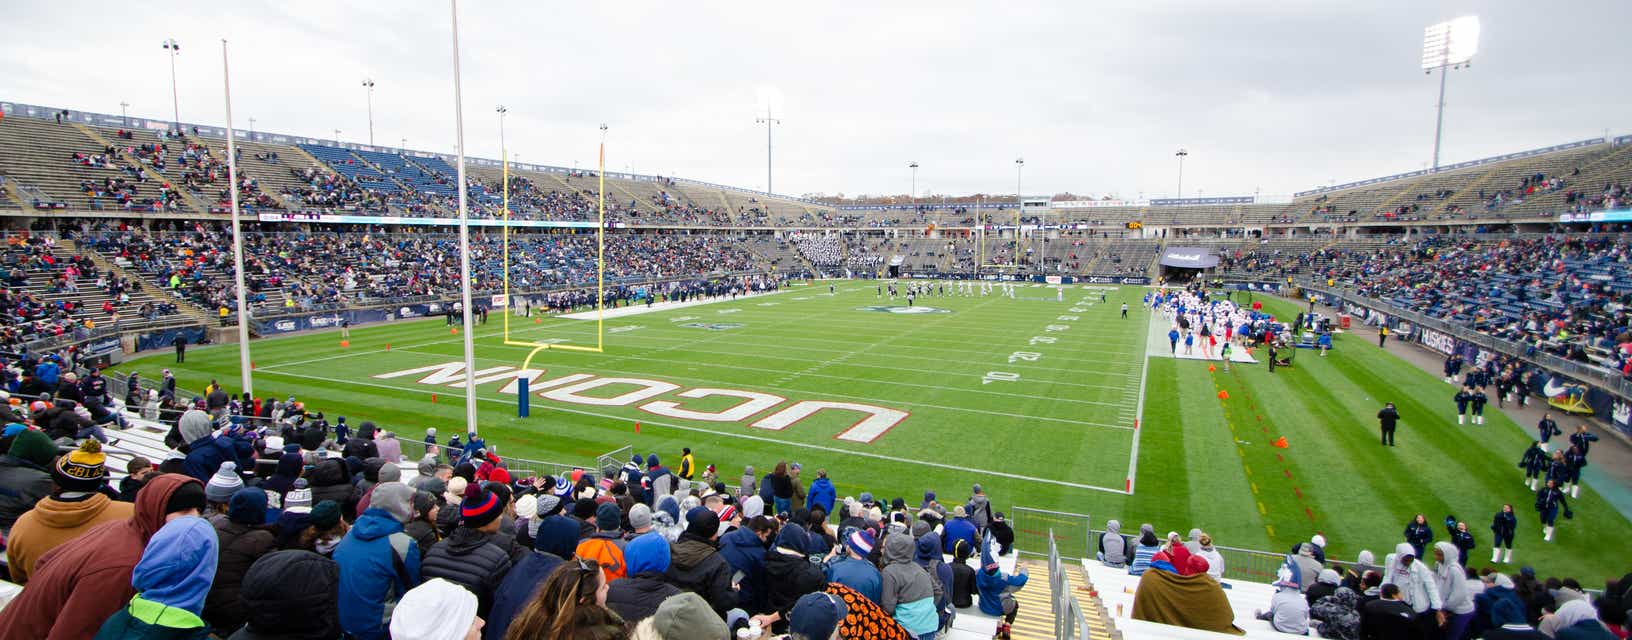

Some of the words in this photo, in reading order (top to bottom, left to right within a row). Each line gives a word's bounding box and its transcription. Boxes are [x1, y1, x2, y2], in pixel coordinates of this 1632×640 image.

[1421, 327, 1455, 354] HUSKIES
[1008, 352, 1041, 363] 20
[983, 372, 1020, 384] 10
[372, 361, 911, 444] UCONN
